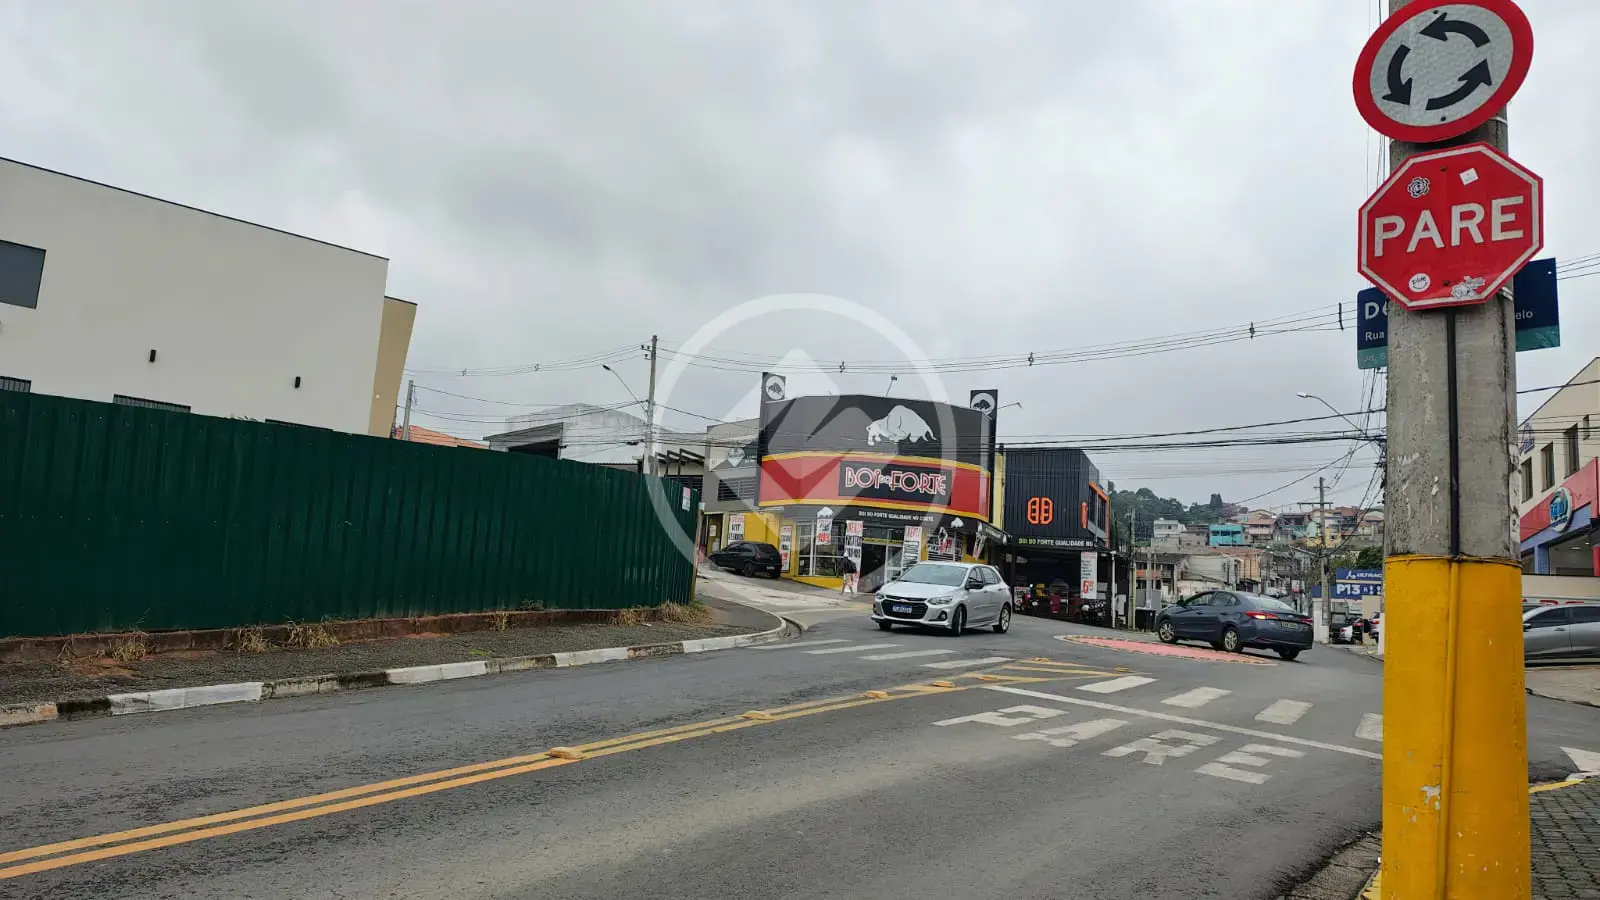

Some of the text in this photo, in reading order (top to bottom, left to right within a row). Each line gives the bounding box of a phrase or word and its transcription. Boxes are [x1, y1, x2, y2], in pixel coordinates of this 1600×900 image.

[1374, 195, 1525, 257] PARE
[1365, 308, 1534, 342] Rua elo
[845, 466, 881, 489] BOI
[889, 470, 947, 496] FORTE
[1037, 538, 1054, 546] FORTE
[1336, 583, 1361, 595] P13
[930, 704, 1307, 785] PARE
